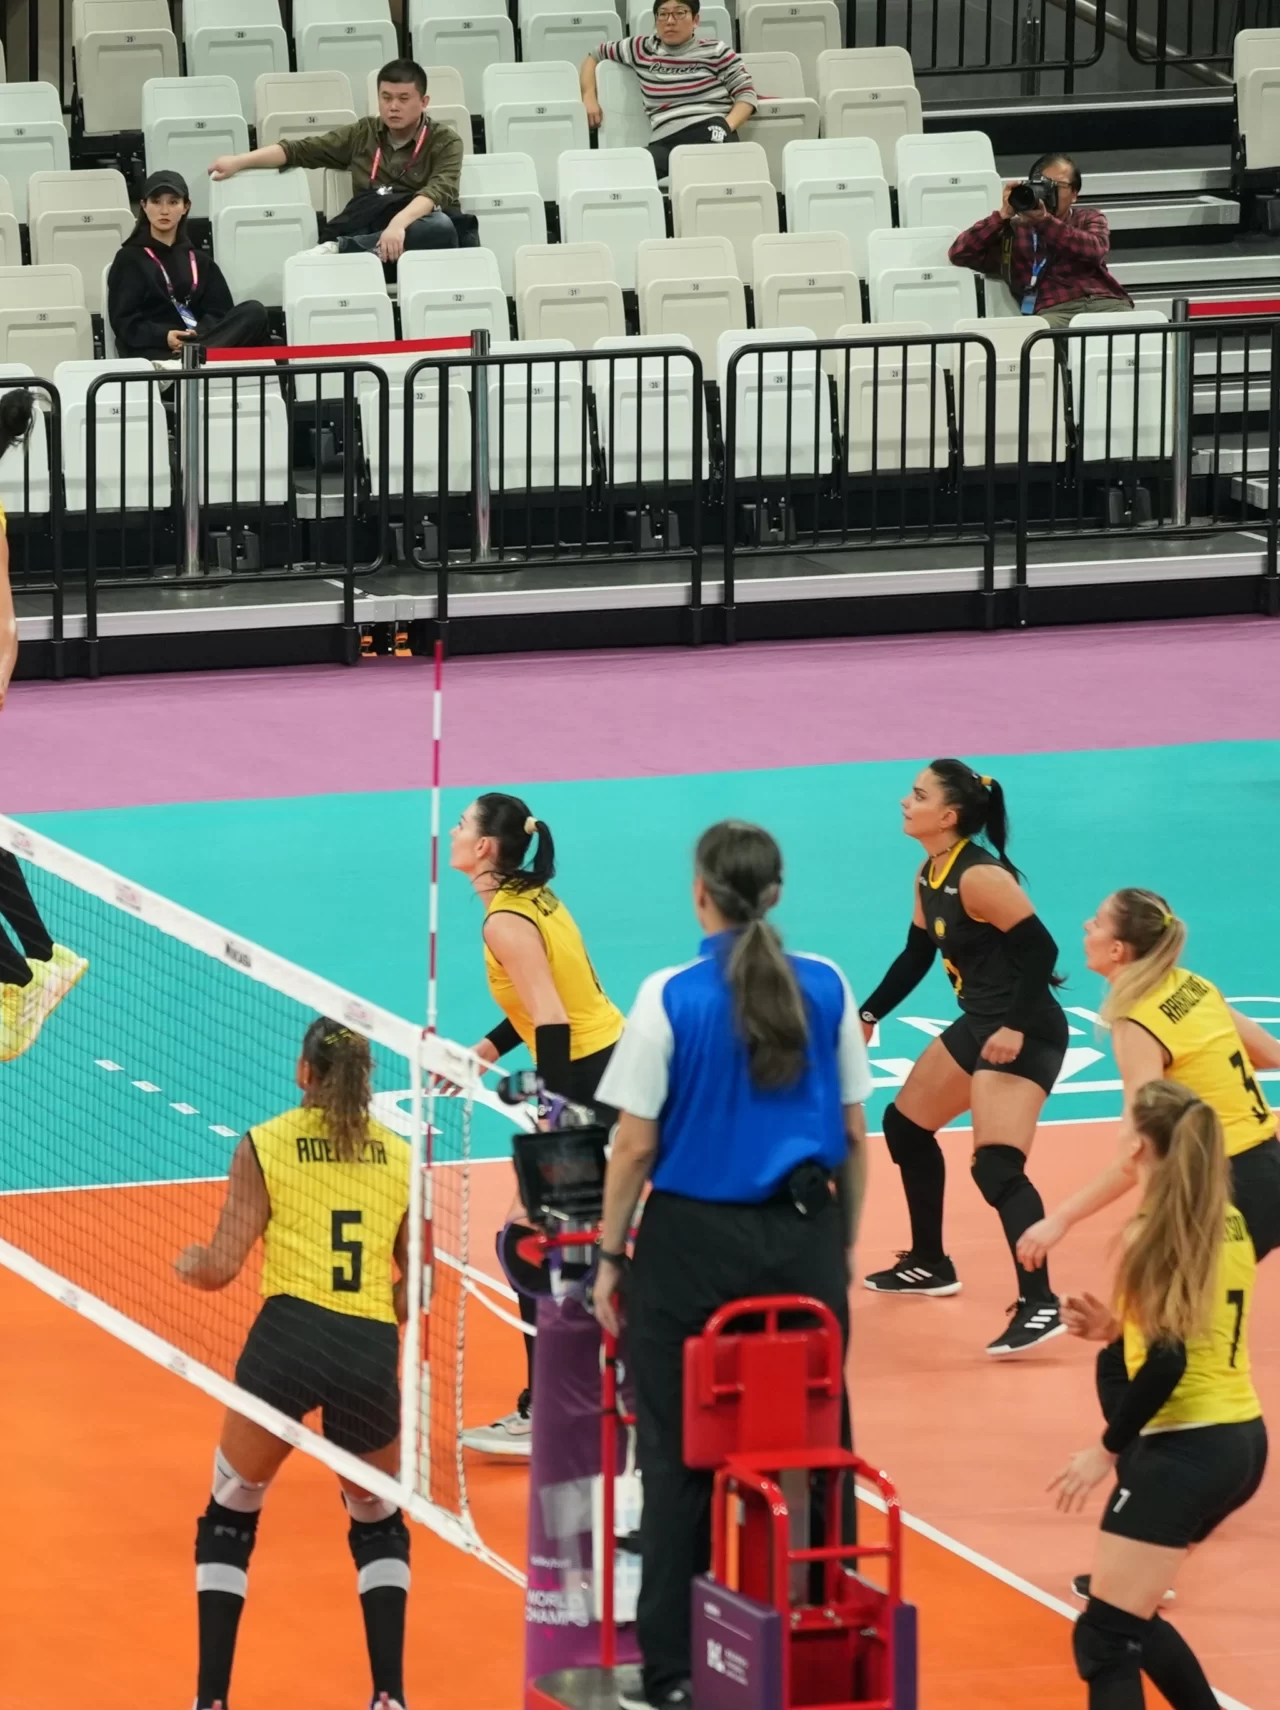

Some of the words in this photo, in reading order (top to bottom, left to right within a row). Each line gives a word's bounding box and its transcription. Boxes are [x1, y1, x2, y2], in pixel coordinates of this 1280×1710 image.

[649, 61, 698, 74] Pencil
[1229, 1050, 1268, 1125] 3
[331, 1210, 363, 1292] 5
[1226, 1289, 1244, 1368] 7
[1113, 1487, 1131, 1513] 7
